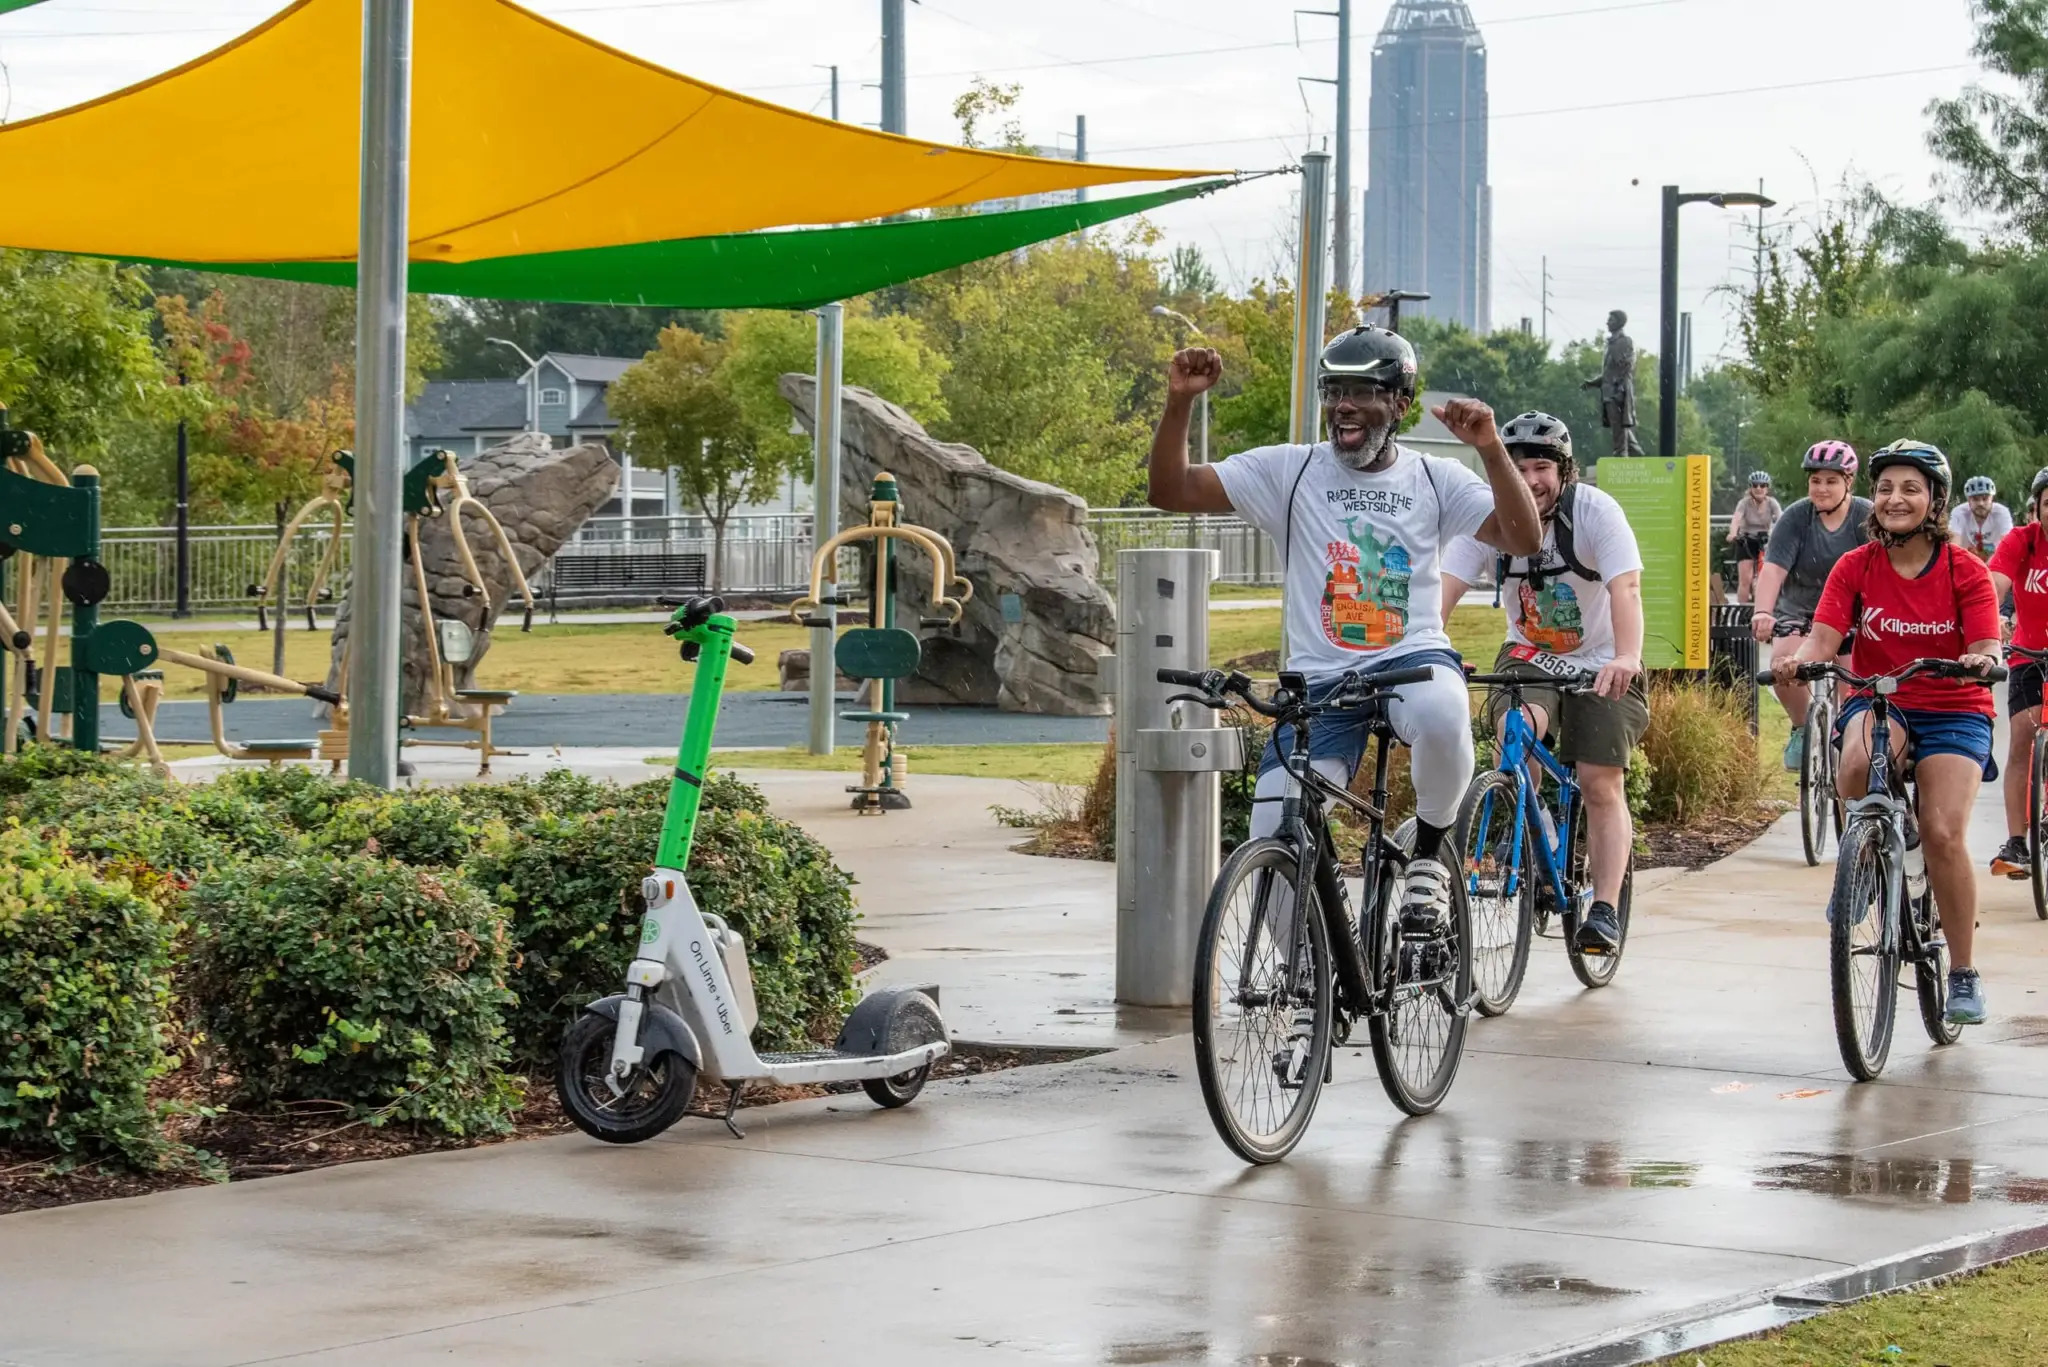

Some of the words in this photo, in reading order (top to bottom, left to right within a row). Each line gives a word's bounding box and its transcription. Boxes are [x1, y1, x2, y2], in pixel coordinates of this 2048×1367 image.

[1691, 464, 1702, 513] ATLANTA
[1343, 501, 1398, 517] WESTSIDE
[1359, 490, 1387, 501] FOR
[1390, 492, 1413, 511] THE
[1691, 516, 1701, 530] DE
[1691, 533, 1701, 577] CIUDAD
[1691, 580, 1700, 592] LA
[1336, 601, 1375, 614] ENGLISH
[1691, 597, 1701, 609] DE
[1345, 611, 1364, 621] AVE
[1880, 617, 1955, 636] Kilpatrick
[1690, 614, 1702, 660] PARQUES
[1534, 652, 1576, 676] 3563
[690, 941, 704, 963] On
[700, 960, 716, 993] Lime
[716, 1002, 733, 1035] Uber
